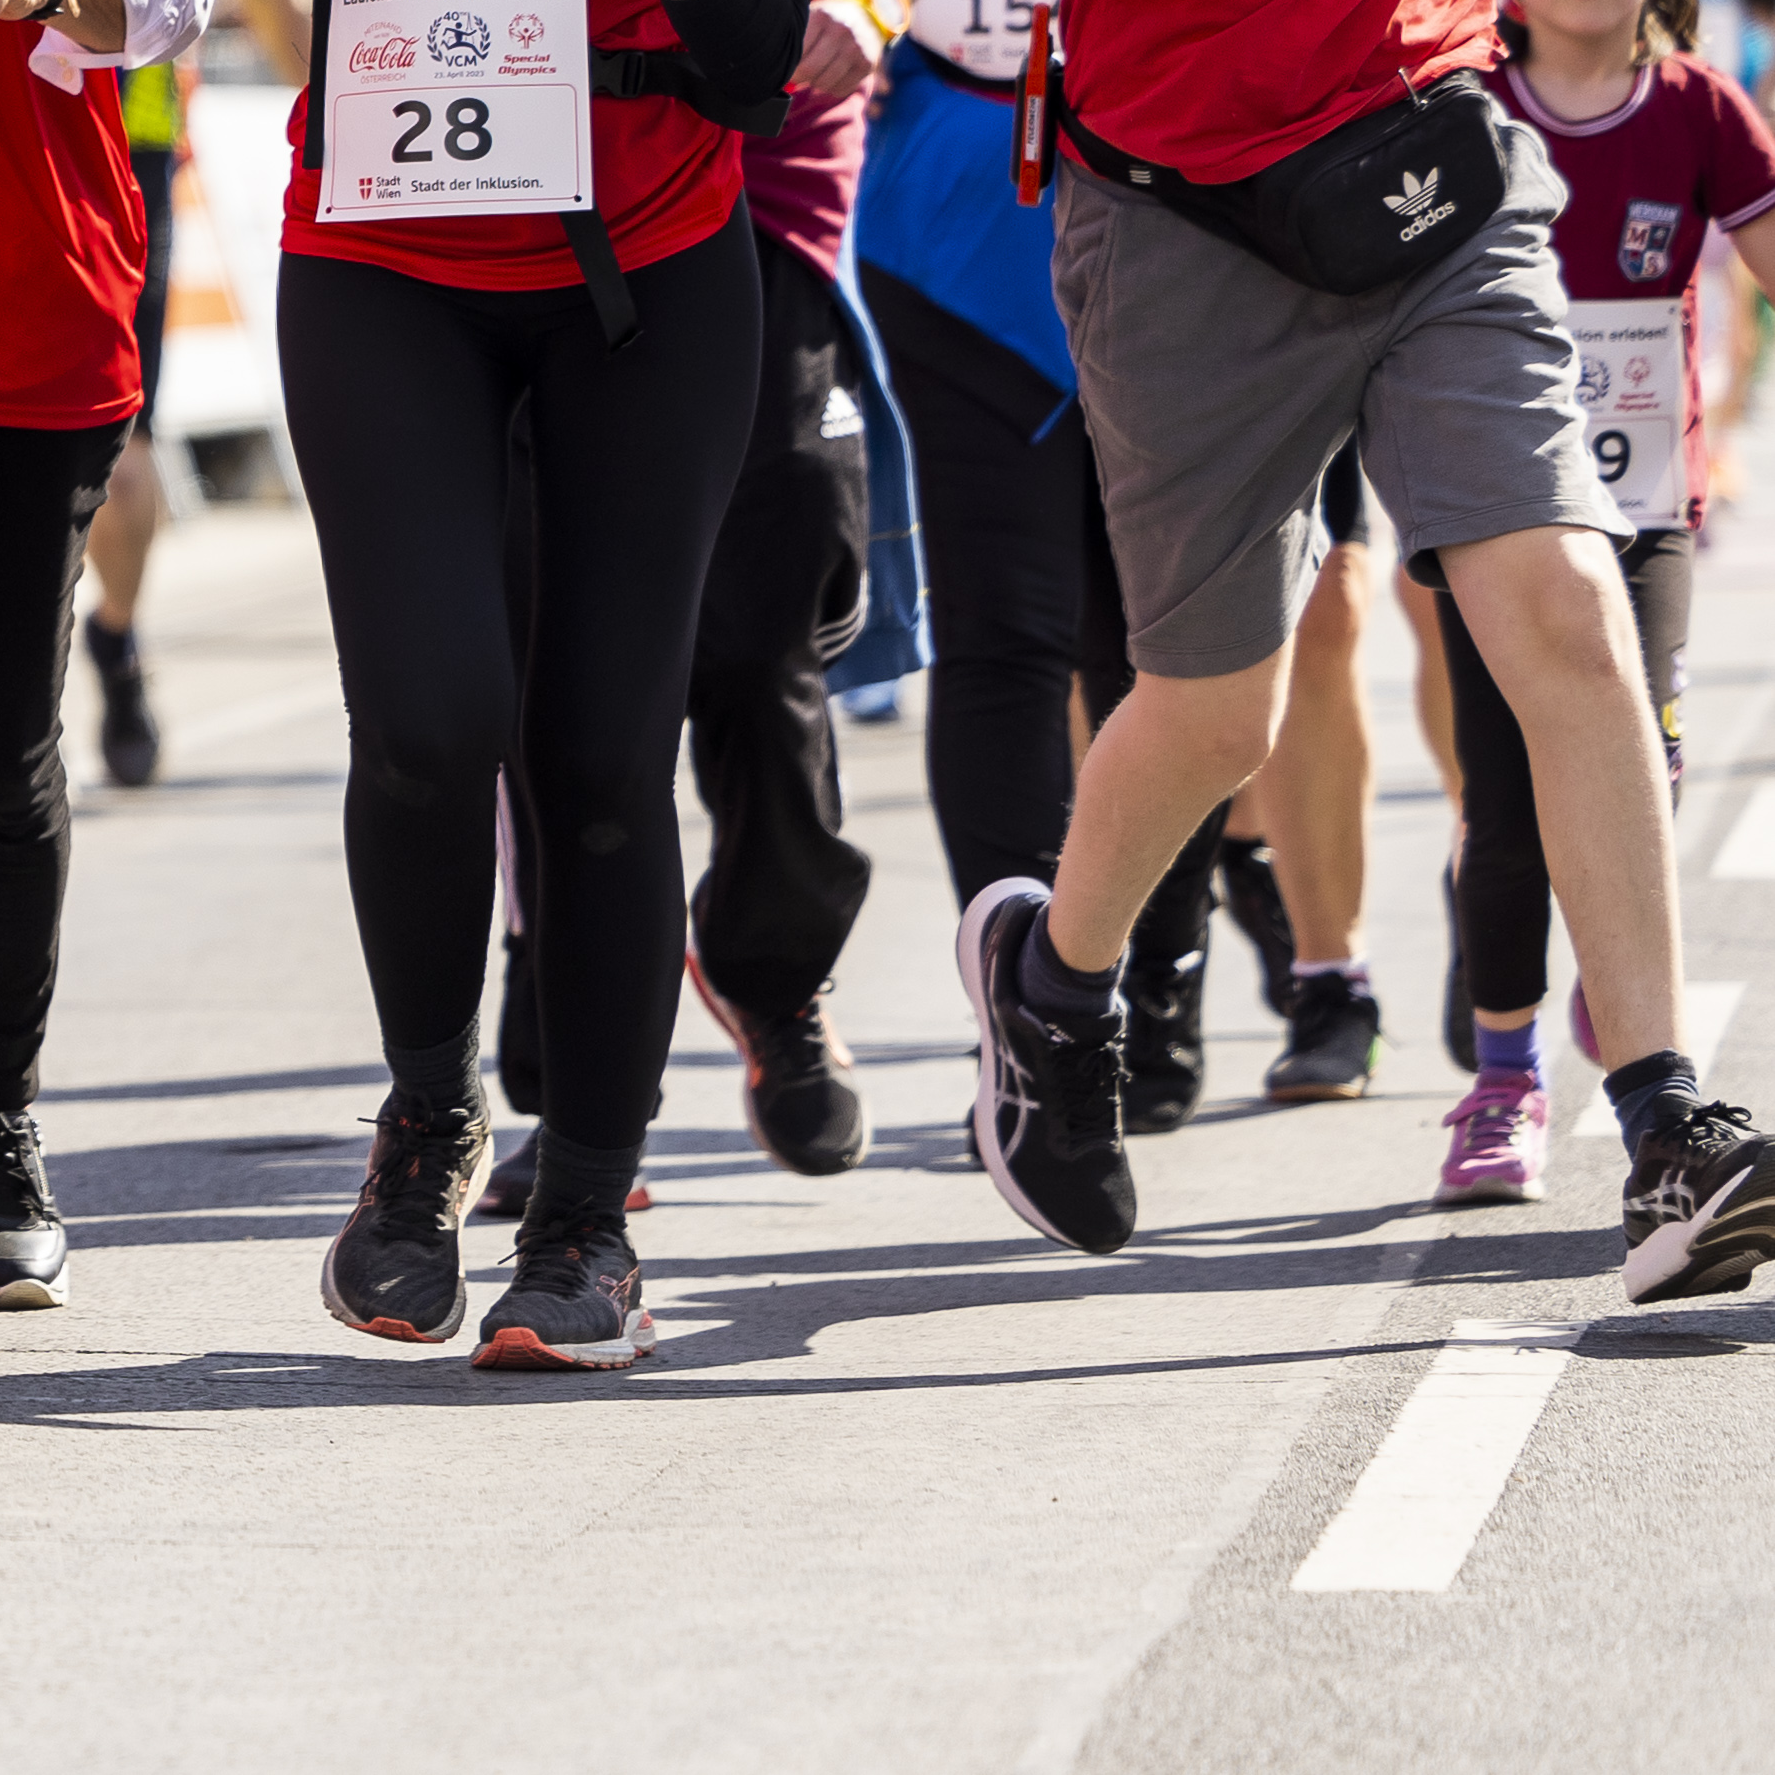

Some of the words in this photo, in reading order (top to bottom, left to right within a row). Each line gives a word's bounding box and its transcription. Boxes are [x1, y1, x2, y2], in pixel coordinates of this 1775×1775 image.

[349, 36, 421, 73] Coca-Cola
[503, 54, 550, 64] Special
[445, 55, 477, 67] VCM
[447, 70, 464, 80] April
[466, 70, 484, 78] 2023
[498, 65, 557, 76] Olympics
[360, 72, 406, 85] ÖSTERREICH
[391, 97, 493, 164] 28
[376, 176, 401, 187] Stadt
[411, 179, 445, 192] Stadt
[449, 179, 471, 191] der
[475, 176, 543, 189] Inklusion.
[376, 187, 401, 199] Wien
[1399, 200, 1455, 242] adidas
[1592, 430, 1631, 483] 9
